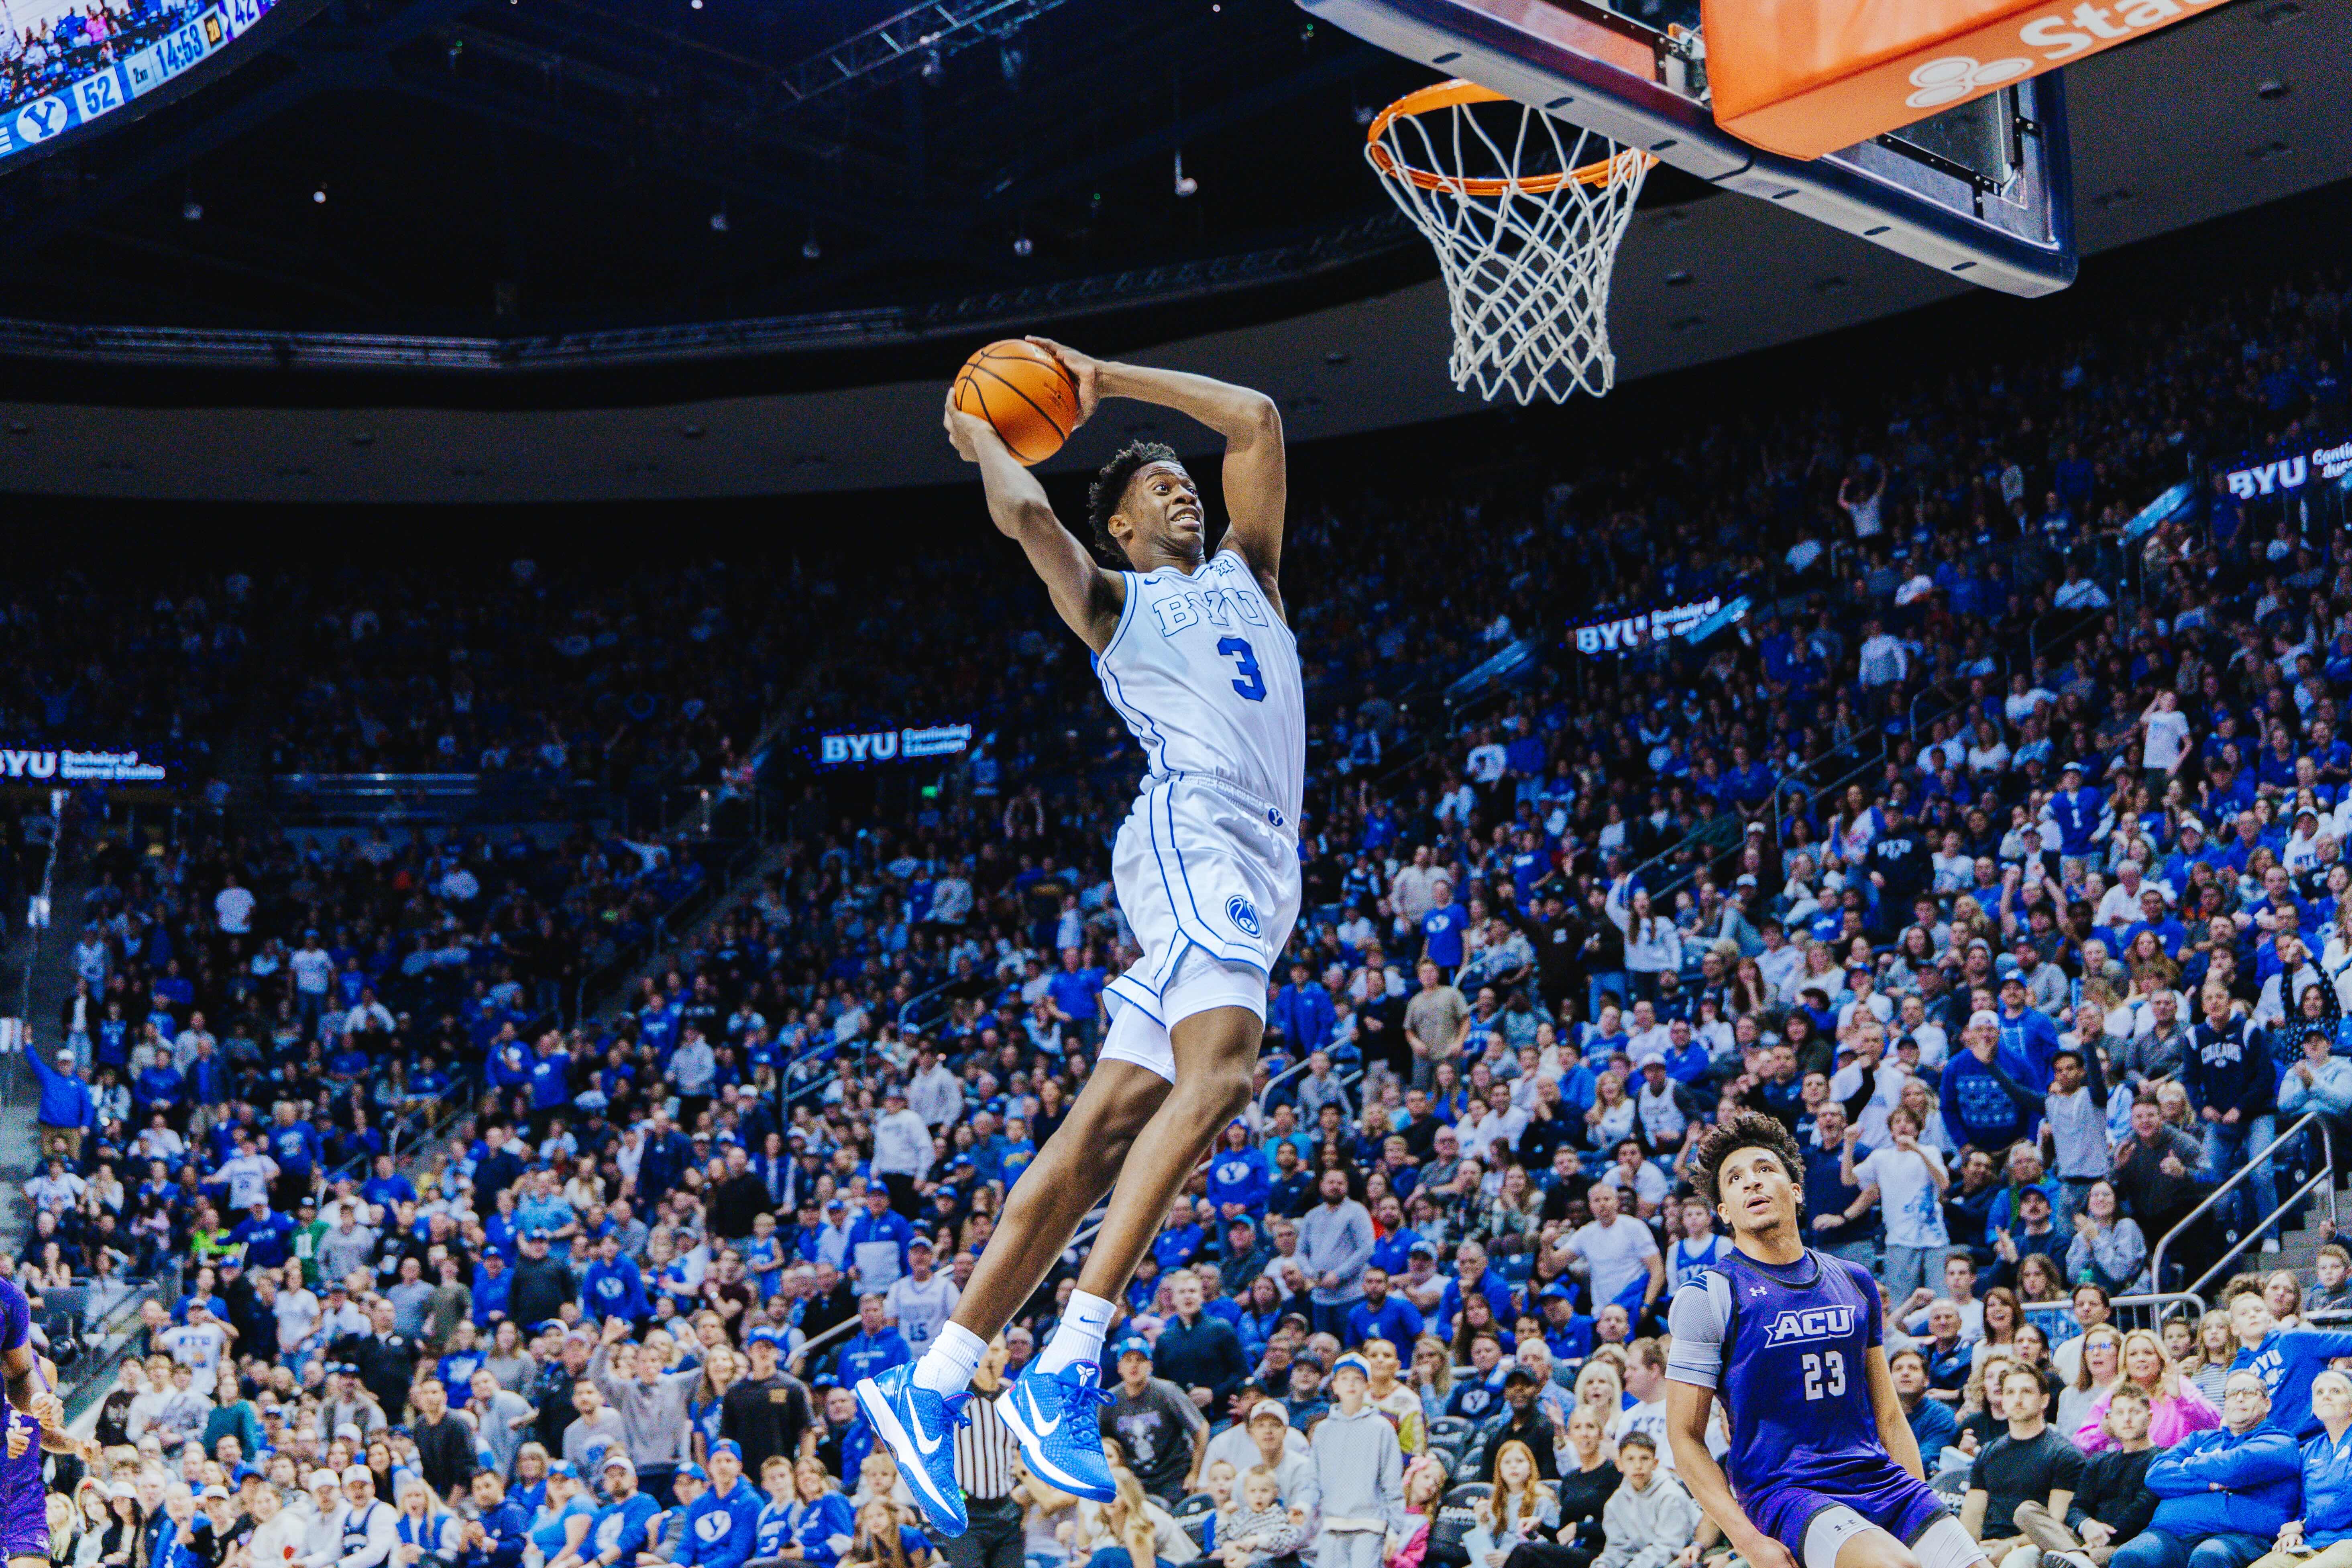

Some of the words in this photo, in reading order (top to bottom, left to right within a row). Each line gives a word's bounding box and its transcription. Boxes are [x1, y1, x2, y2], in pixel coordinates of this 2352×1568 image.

[2019, 0, 2209, 60] Sta
[156, 24, 204, 77] 14:53
[83, 76, 116, 114] 52
[24, 101, 56, 138] Y
[2227, 456, 2306, 499] BYU
[1153, 588, 1268, 637] BYU
[1576, 615, 1647, 654] BYU
[1217, 637, 1267, 702] 3
[0, 749, 57, 779] YU
[61, 750, 120, 766] Bachelor
[822, 731, 898, 763] BYU
[61, 764, 114, 780] General
[115, 763, 166, 780] Studies
[1774, 1308, 1848, 1340] ACU
[1802, 1350, 1845, 1401] 23
[2249, 1349, 2283, 1377] BYU
